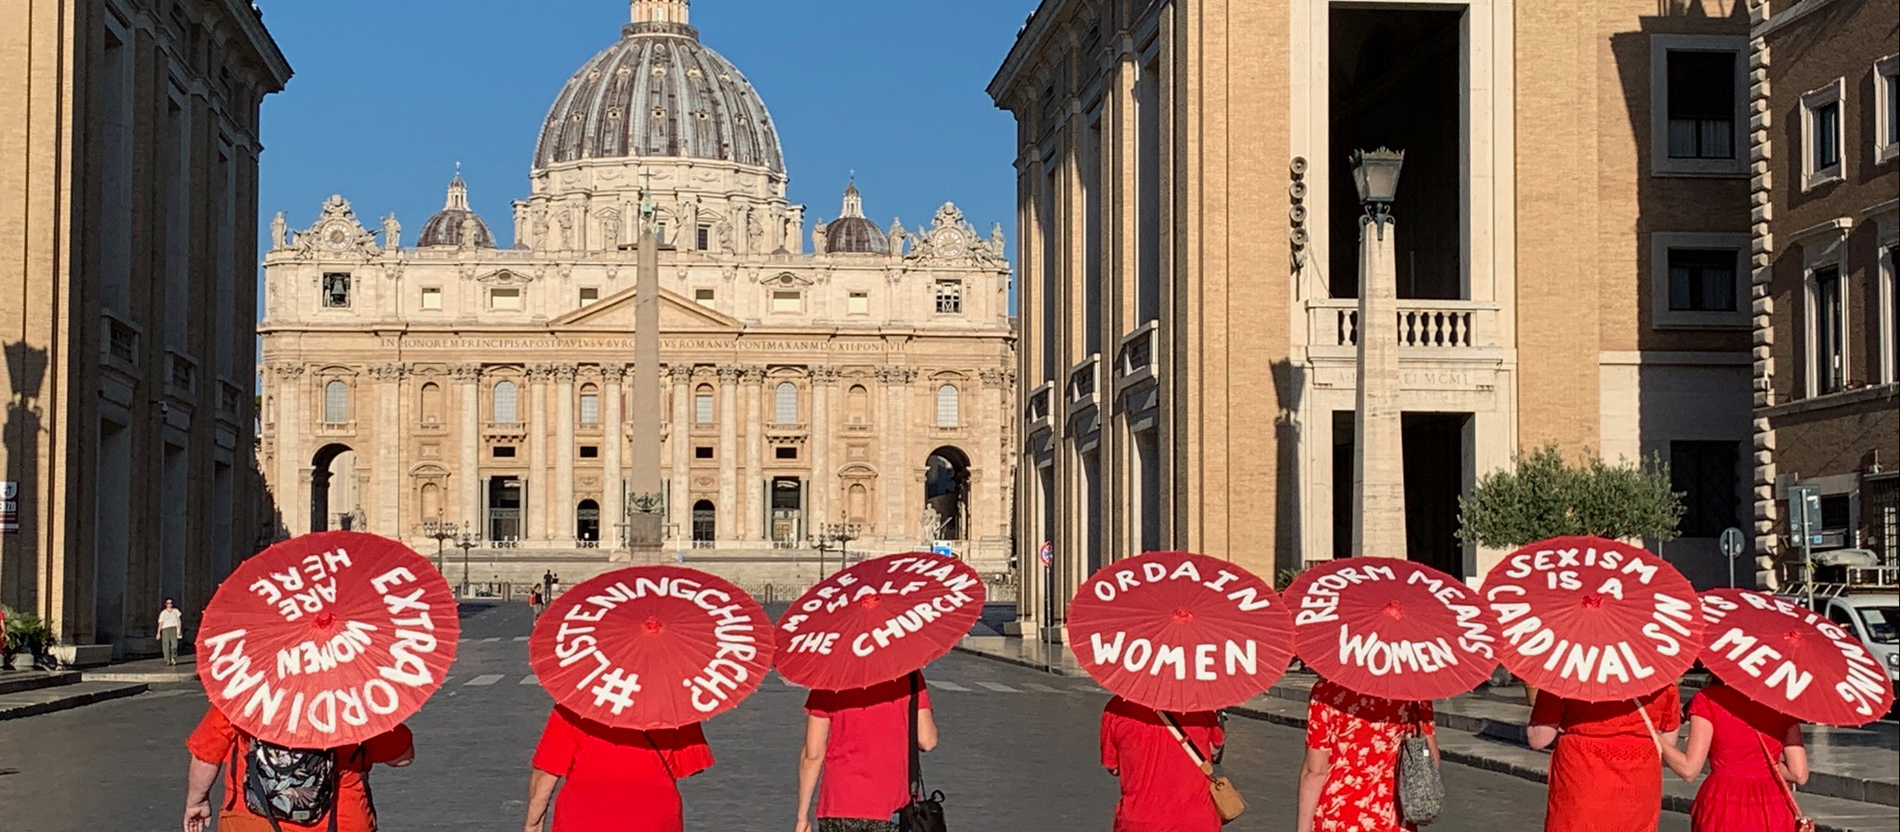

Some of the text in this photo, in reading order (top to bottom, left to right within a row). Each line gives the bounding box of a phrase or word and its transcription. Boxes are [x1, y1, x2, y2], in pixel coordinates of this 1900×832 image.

[381, 338, 395, 347] IN
[400, 338, 459, 348] HONOREM
[461, 338, 520, 348] PRINCIPIS
[557, 339, 595, 348] PAVLVS
[679, 339, 736, 349] ROMANVS
[249, 548, 352, 605] HERE
[1094, 560, 1271, 612] ORDAIN
[1506, 547, 1658, 584] SEXISM
[1547, 571, 1623, 600] IS A
[278, 577, 337, 622] ARE
[781, 557, 978, 632] MORE THAN
[826, 581, 928, 614] HALF
[1295, 565, 1495, 659] REFORM MEANS
[204, 566, 438, 734] EXTRAORDINARY
[276, 620, 378, 680] WOMEN
[786, 591, 975, 657] THE CHURCH
[1339, 624, 1459, 676] WOMEN
[1487, 585, 1693, 684] CARDINAL SIN
[1090, 631, 1257, 681] WOMEN
[1709, 627, 1814, 701] MEN
[1739, 592, 1886, 716] REIGNING
